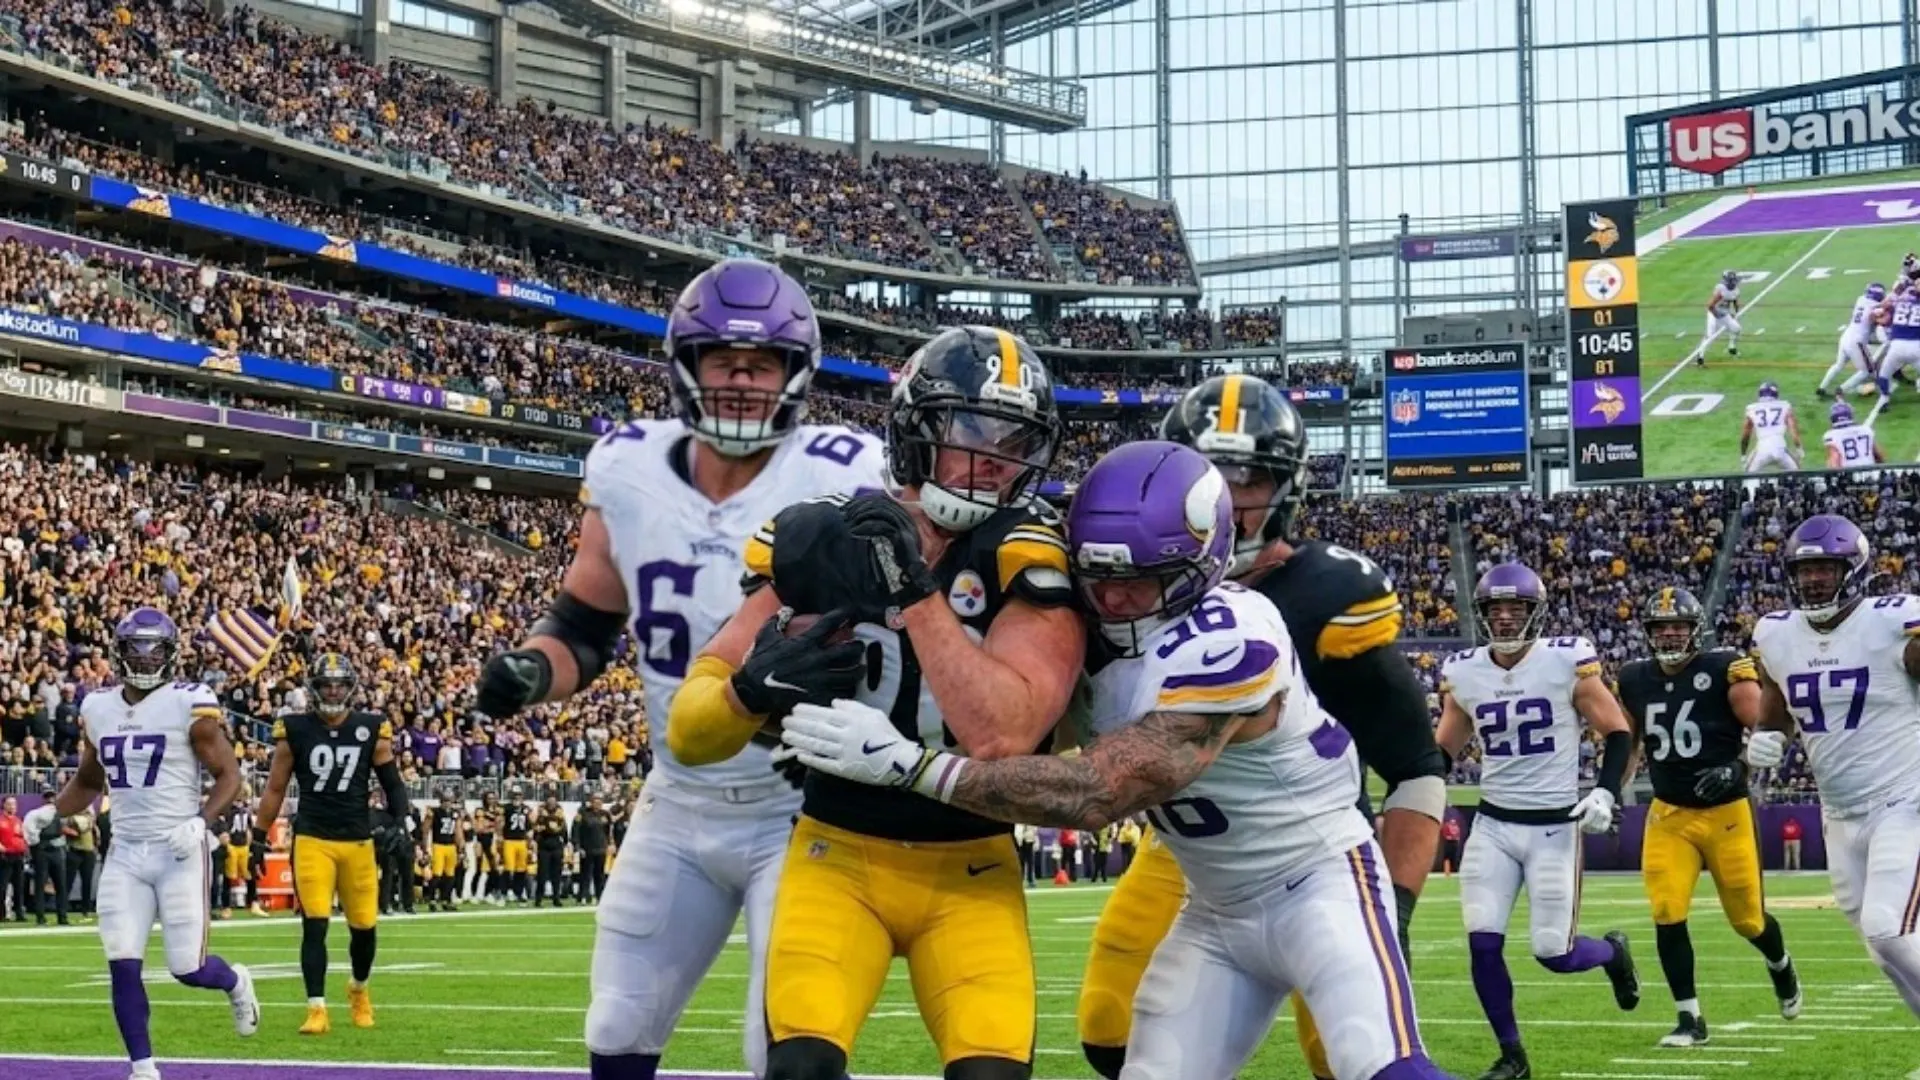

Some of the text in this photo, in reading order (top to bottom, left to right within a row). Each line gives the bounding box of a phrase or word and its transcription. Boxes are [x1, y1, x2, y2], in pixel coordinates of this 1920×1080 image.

[1675, 122, 1747, 163] us
[0, 311, 79, 341] kstadium
[1578, 332, 1633, 355] 10:45
[1755, 407, 1783, 428] 37
[1787, 667, 1870, 733] 97
[1476, 698, 1555, 756] 22
[1645, 699, 1702, 761] 56
[100, 734, 166, 788] 97
[309, 744, 361, 792] 97
